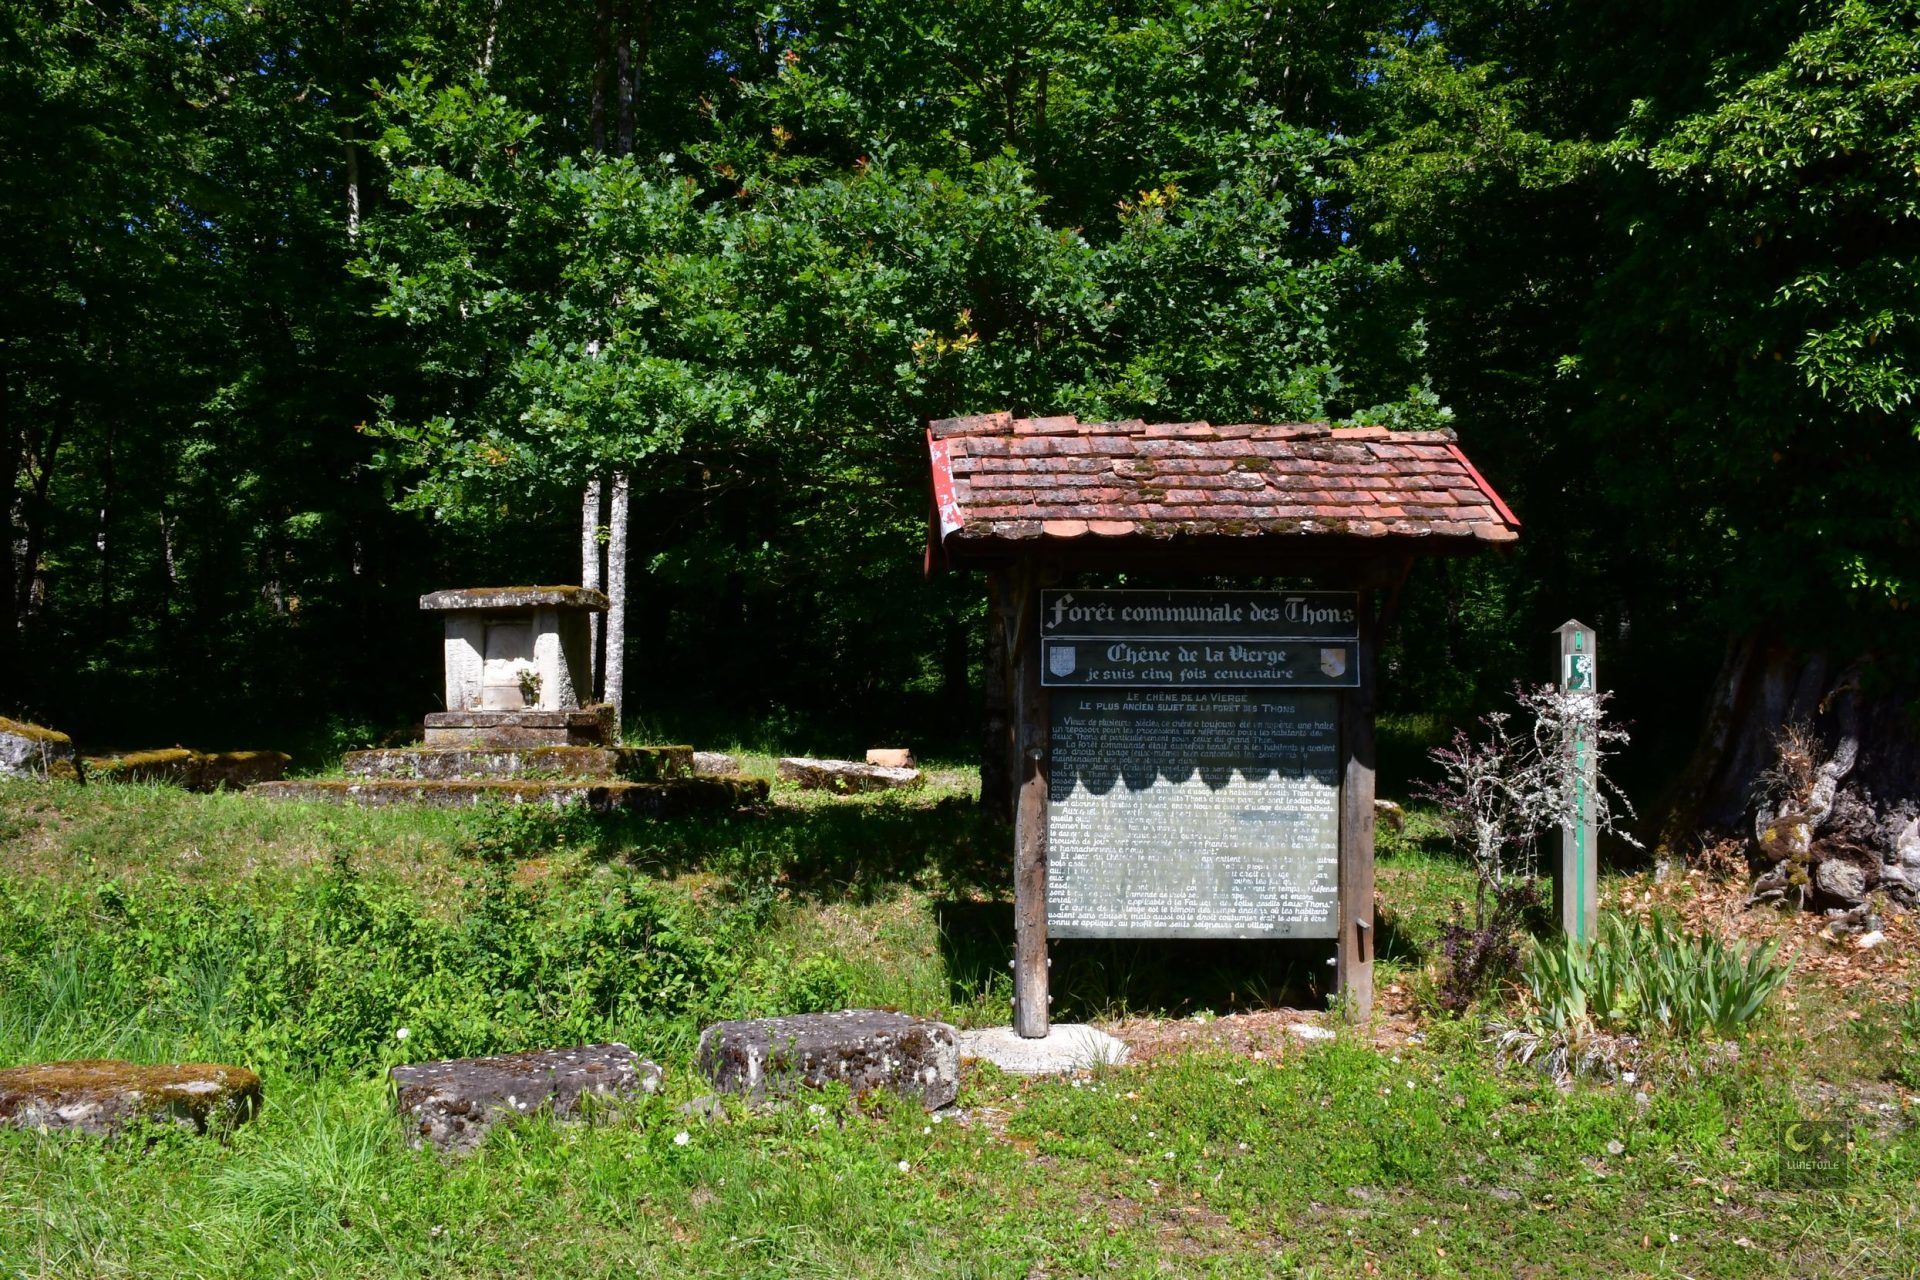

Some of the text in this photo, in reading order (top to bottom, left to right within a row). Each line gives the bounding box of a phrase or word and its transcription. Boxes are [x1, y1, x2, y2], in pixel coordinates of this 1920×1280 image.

[1046, 593, 1355, 629] Forêt communale des Thons
[1107, 643, 1287, 667] Chêne de la Vierge
[1085, 669, 1293, 682] je suis cinq fois centenaire
[1096, 702, 1120, 711] PLUS
[1157, 703, 1184, 712] SUJET
[1186, 704, 1197, 712] DE
